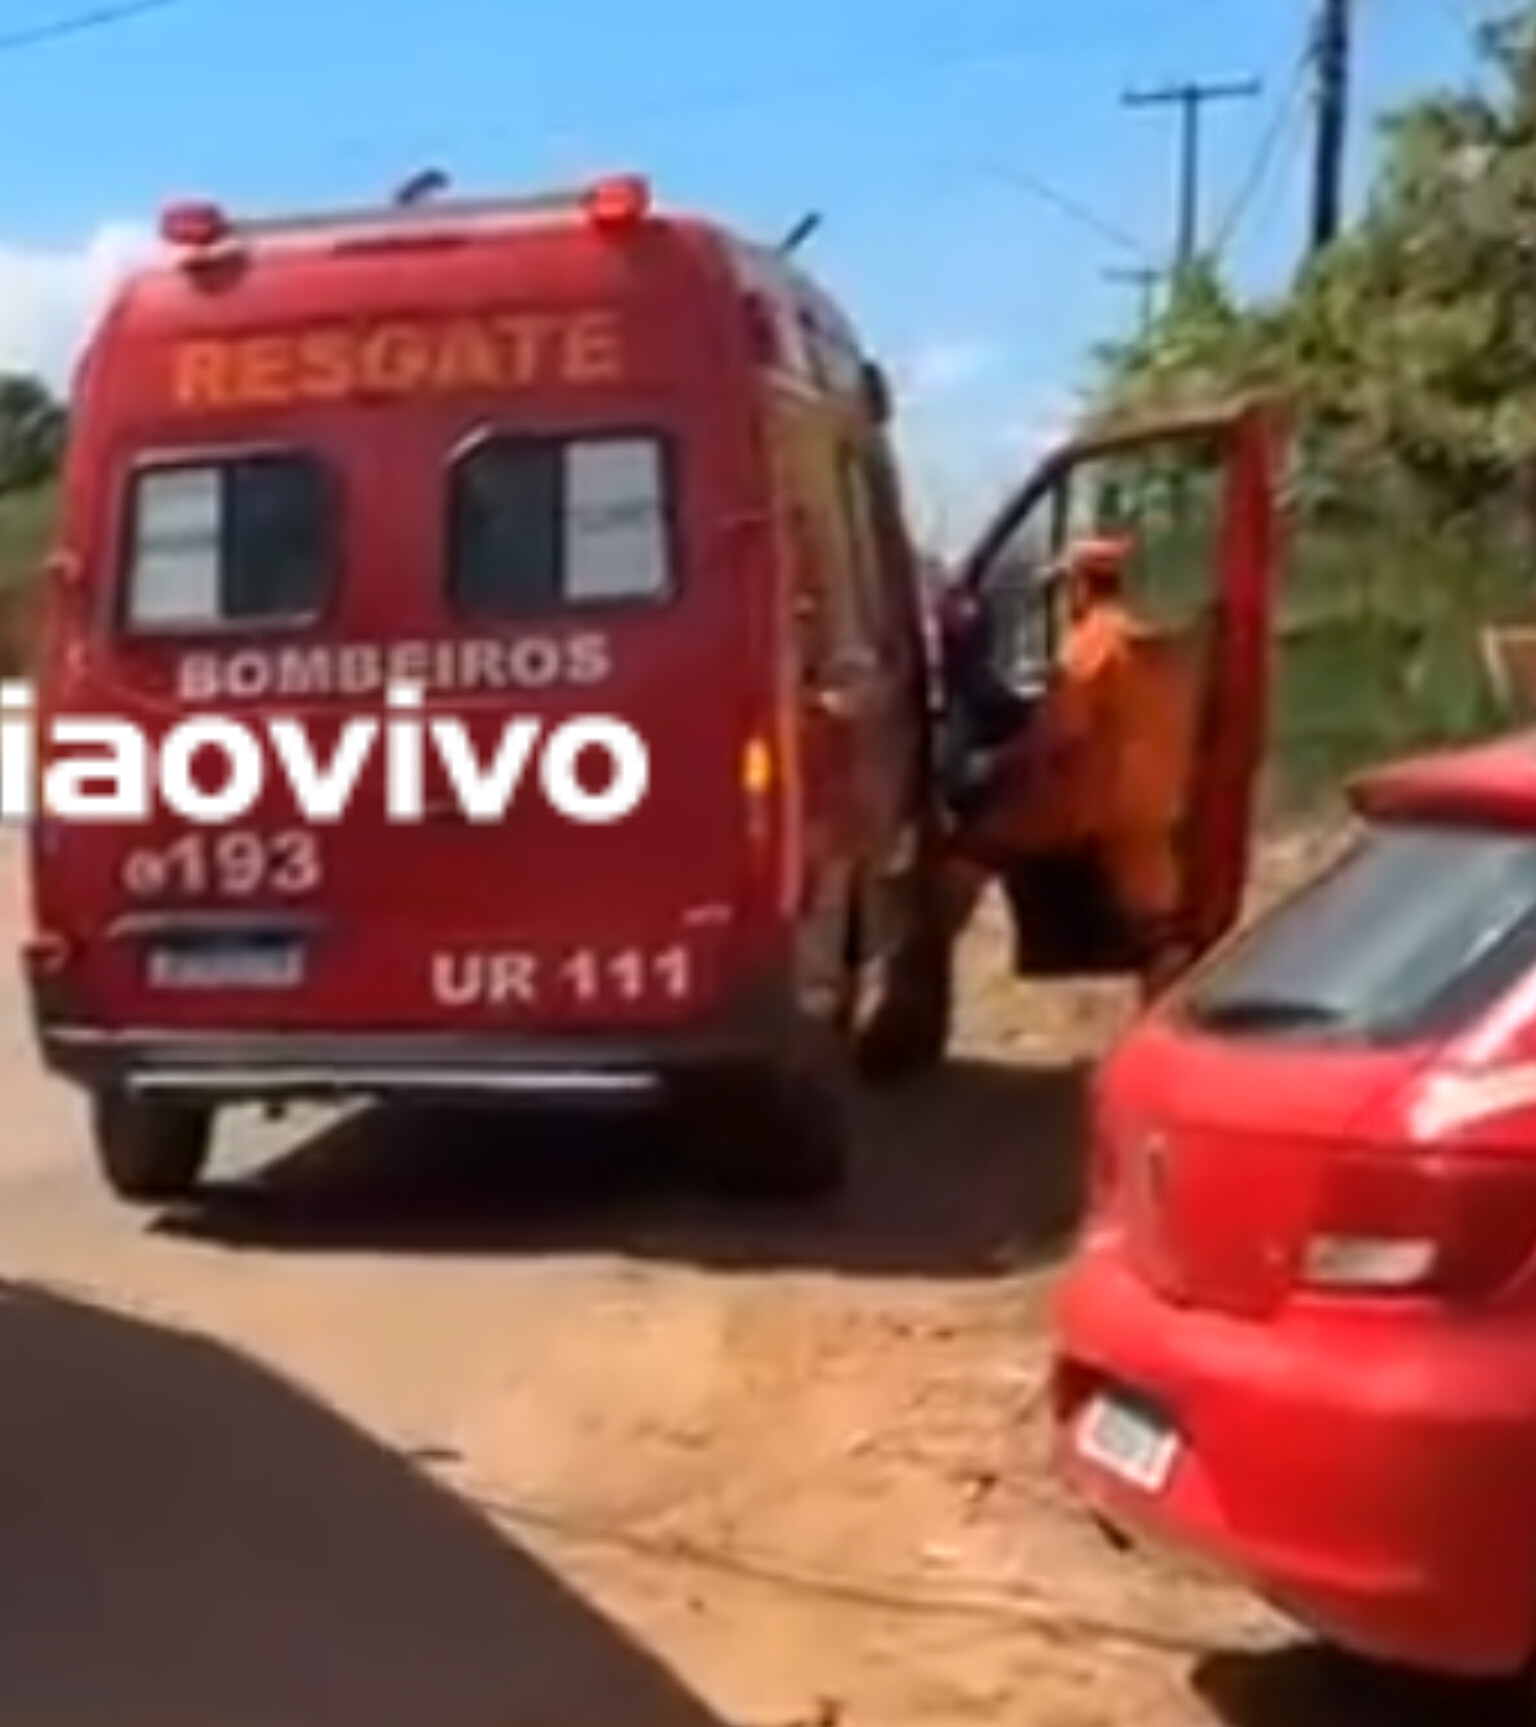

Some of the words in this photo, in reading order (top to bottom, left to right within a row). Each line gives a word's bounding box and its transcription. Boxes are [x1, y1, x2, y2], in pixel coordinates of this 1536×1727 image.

[176, 312, 624, 406] RESGATE
[177, 634, 613, 700] BOMBEIROS
[432, 950, 536, 1003] UR
[564, 945, 690, 999] 111
